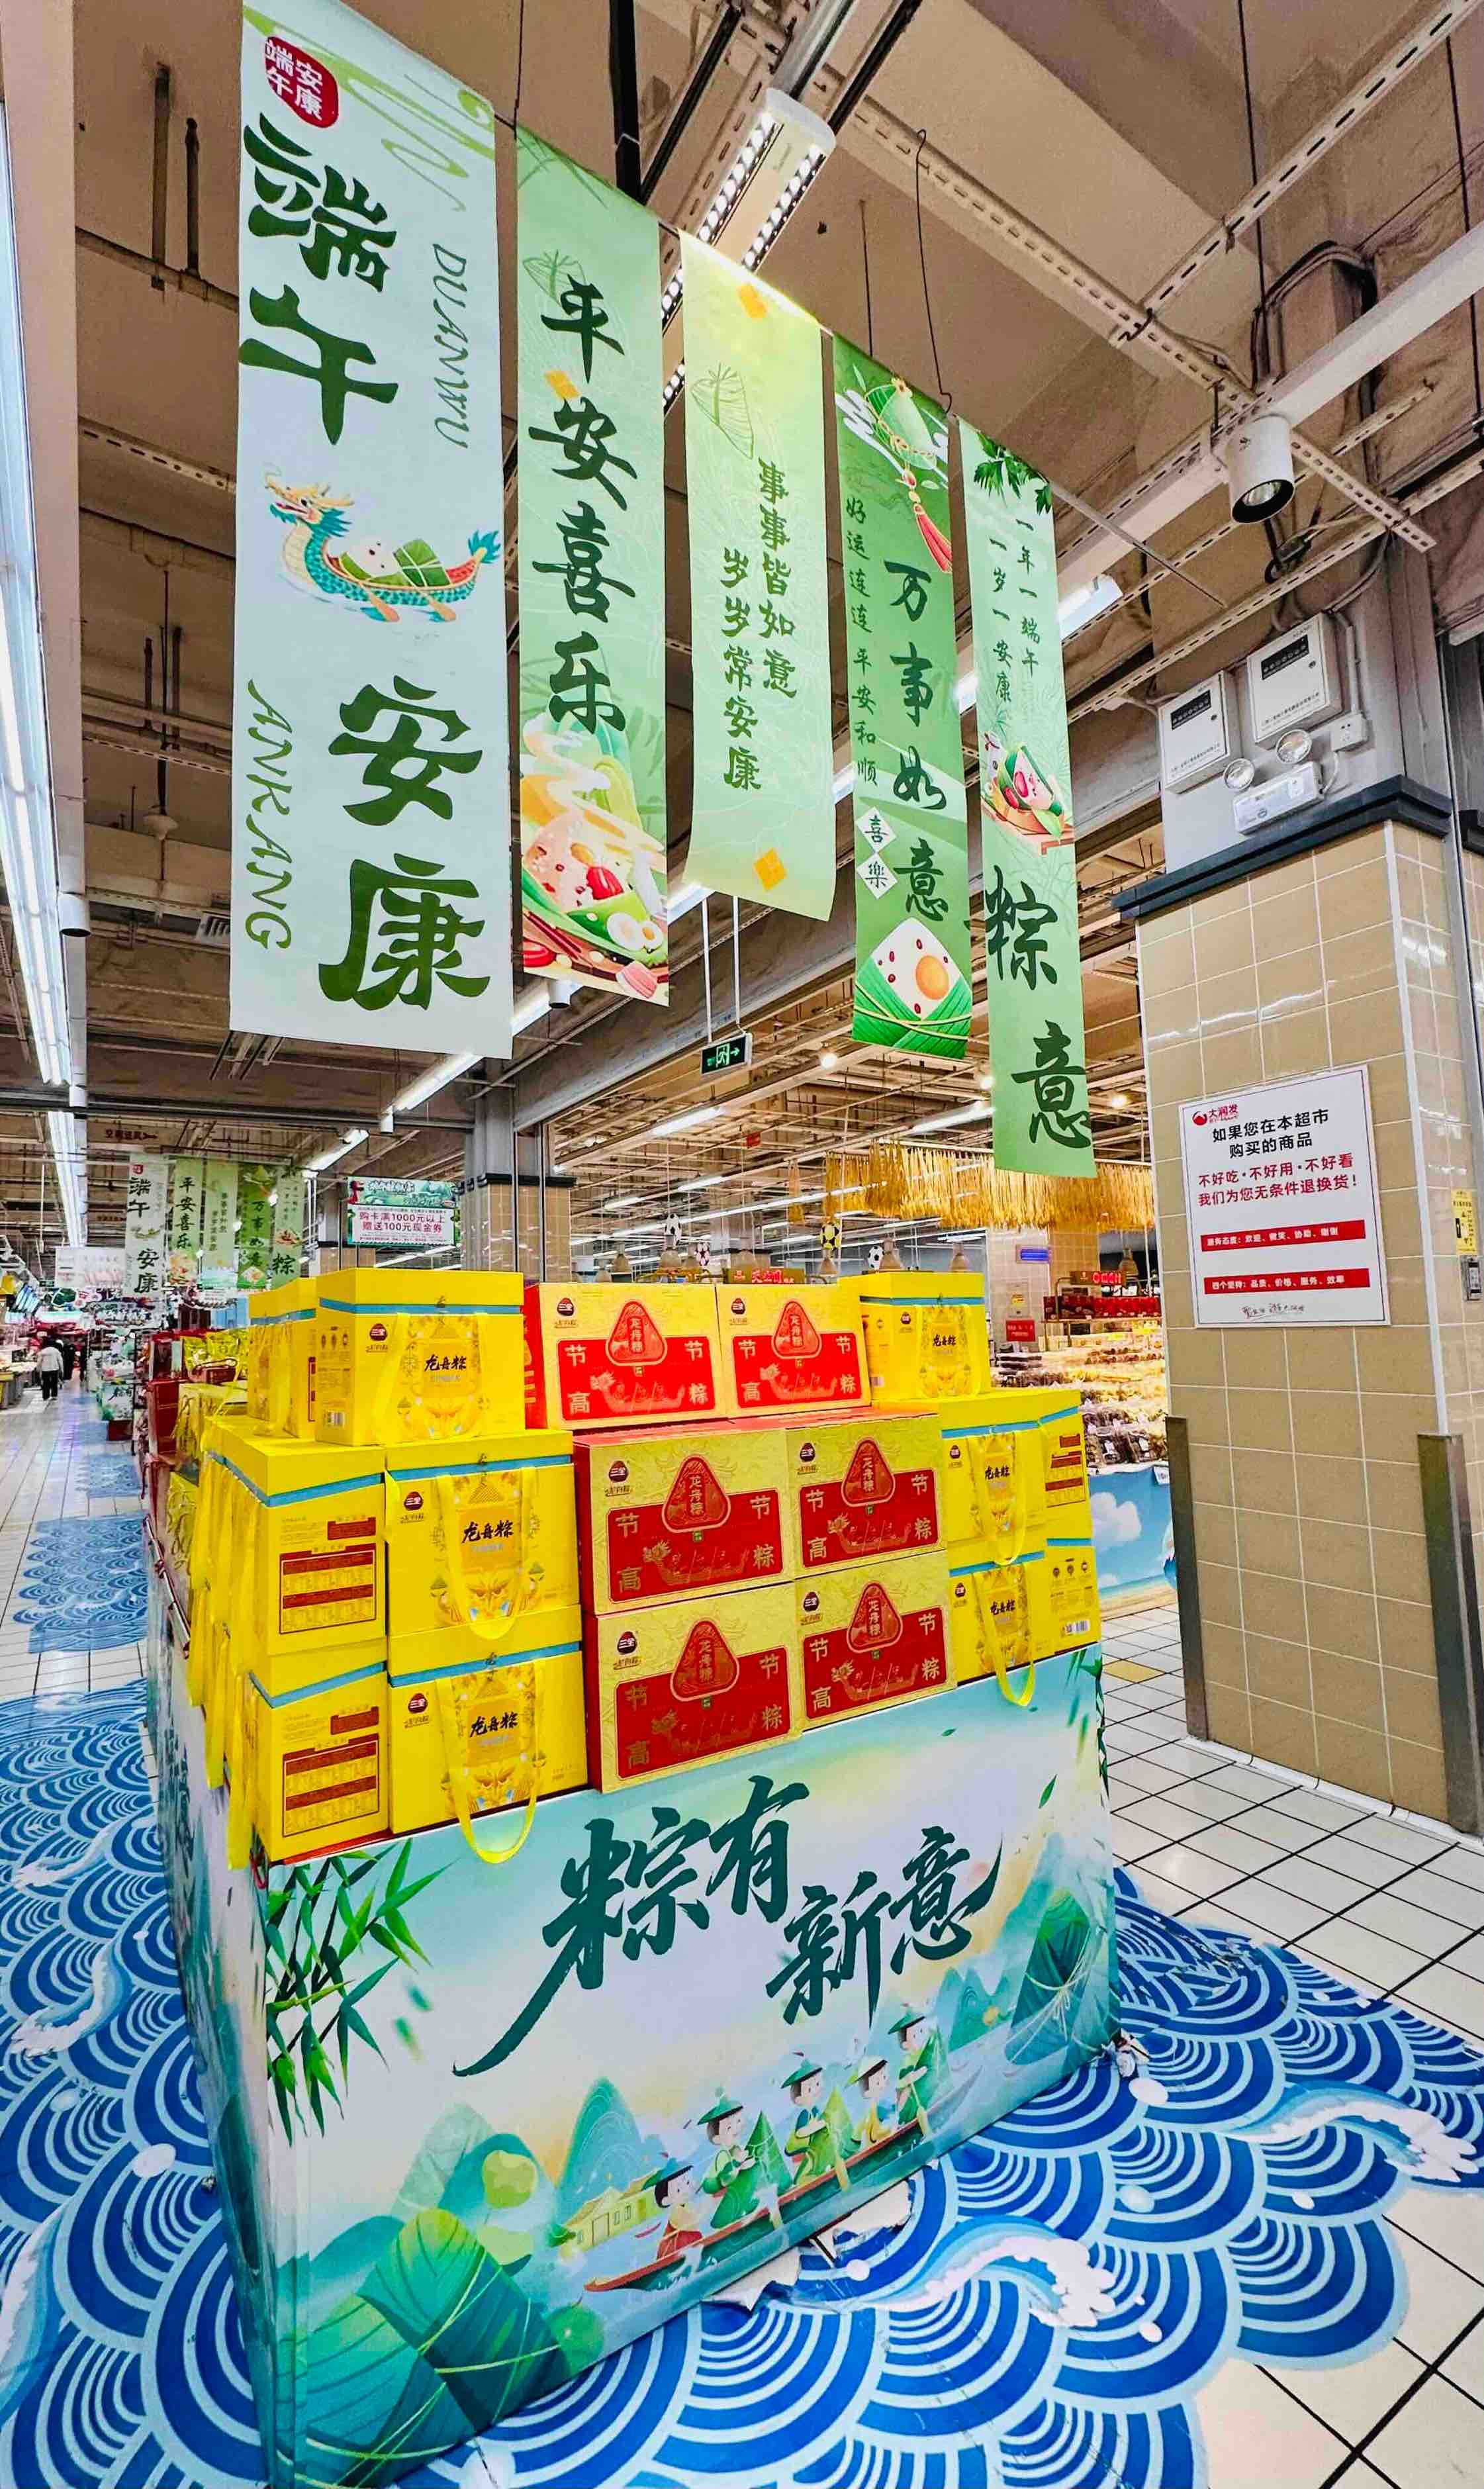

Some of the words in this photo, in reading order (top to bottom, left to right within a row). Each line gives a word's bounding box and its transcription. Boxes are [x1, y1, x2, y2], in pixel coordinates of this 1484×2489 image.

[239, 113, 399, 446] 端午
[432, 242, 471, 449] DUANWU
[530, 274, 638, 735] 平安喜乐
[759, 458, 798, 698] 事事皆如意
[1015, 518, 1041, 677] 一年一端午
[989, 537, 1013, 703] 一岁一安康
[721, 547, 762, 790] 岁岁常安康
[884, 561, 949, 921] 万事如意
[246, 679, 293, 949] ANKANG
[319, 675, 490, 1011] 安康
[982, 865, 1092, 1149] 粽意
[1212, 1109, 1329, 1143] 如果您在本超市
[1229, 1132, 1313, 1158] 购买的商品
[128, 1177, 151, 1218] 端午
[176, 1176, 197, 1249] 平安喜乐
[359, 1211, 445, 1223] 购卡满1000元以上
[134, 1248, 160, 1293] 安康
[565, 1344, 586, 1367] 节
[684, 1340, 703, 1362] 节
[738, 1340, 756, 1359] 节
[835, 1336, 851, 1354] 节
[424, 1354, 467, 1372] 龙舟粽
[689, 1383, 709, 1404] 粽
[741, 1382, 760, 1402] 高
[840, 1374, 856, 1393] 粽
[569, 1392, 590, 1415] 高
[911, 1474, 928, 1497] 节
[750, 1495, 771, 1520] 节
[806, 1489, 825, 1513] 节
[461, 1520, 514, 1544] 龙舟粽
[616, 1513, 640, 1538] 节
[914, 1517, 932, 1540] 粽
[753, 1544, 774, 1570] 粽
[807, 1536, 827, 1561] 高
[616, 1566, 643, 1593] 高
[918, 1613, 936, 1636] 节
[810, 1638, 829, 1662] 节
[759, 1655, 780, 1679] 节
[922, 1657, 940, 1681] 粽
[625, 1685, 647, 1710] 节
[812, 1686, 831, 1711] 高
[469, 1712, 519, 1738] 龙舟粽
[762, 1705, 783, 1730] 粽
[626, 1741, 651, 1767] 高
